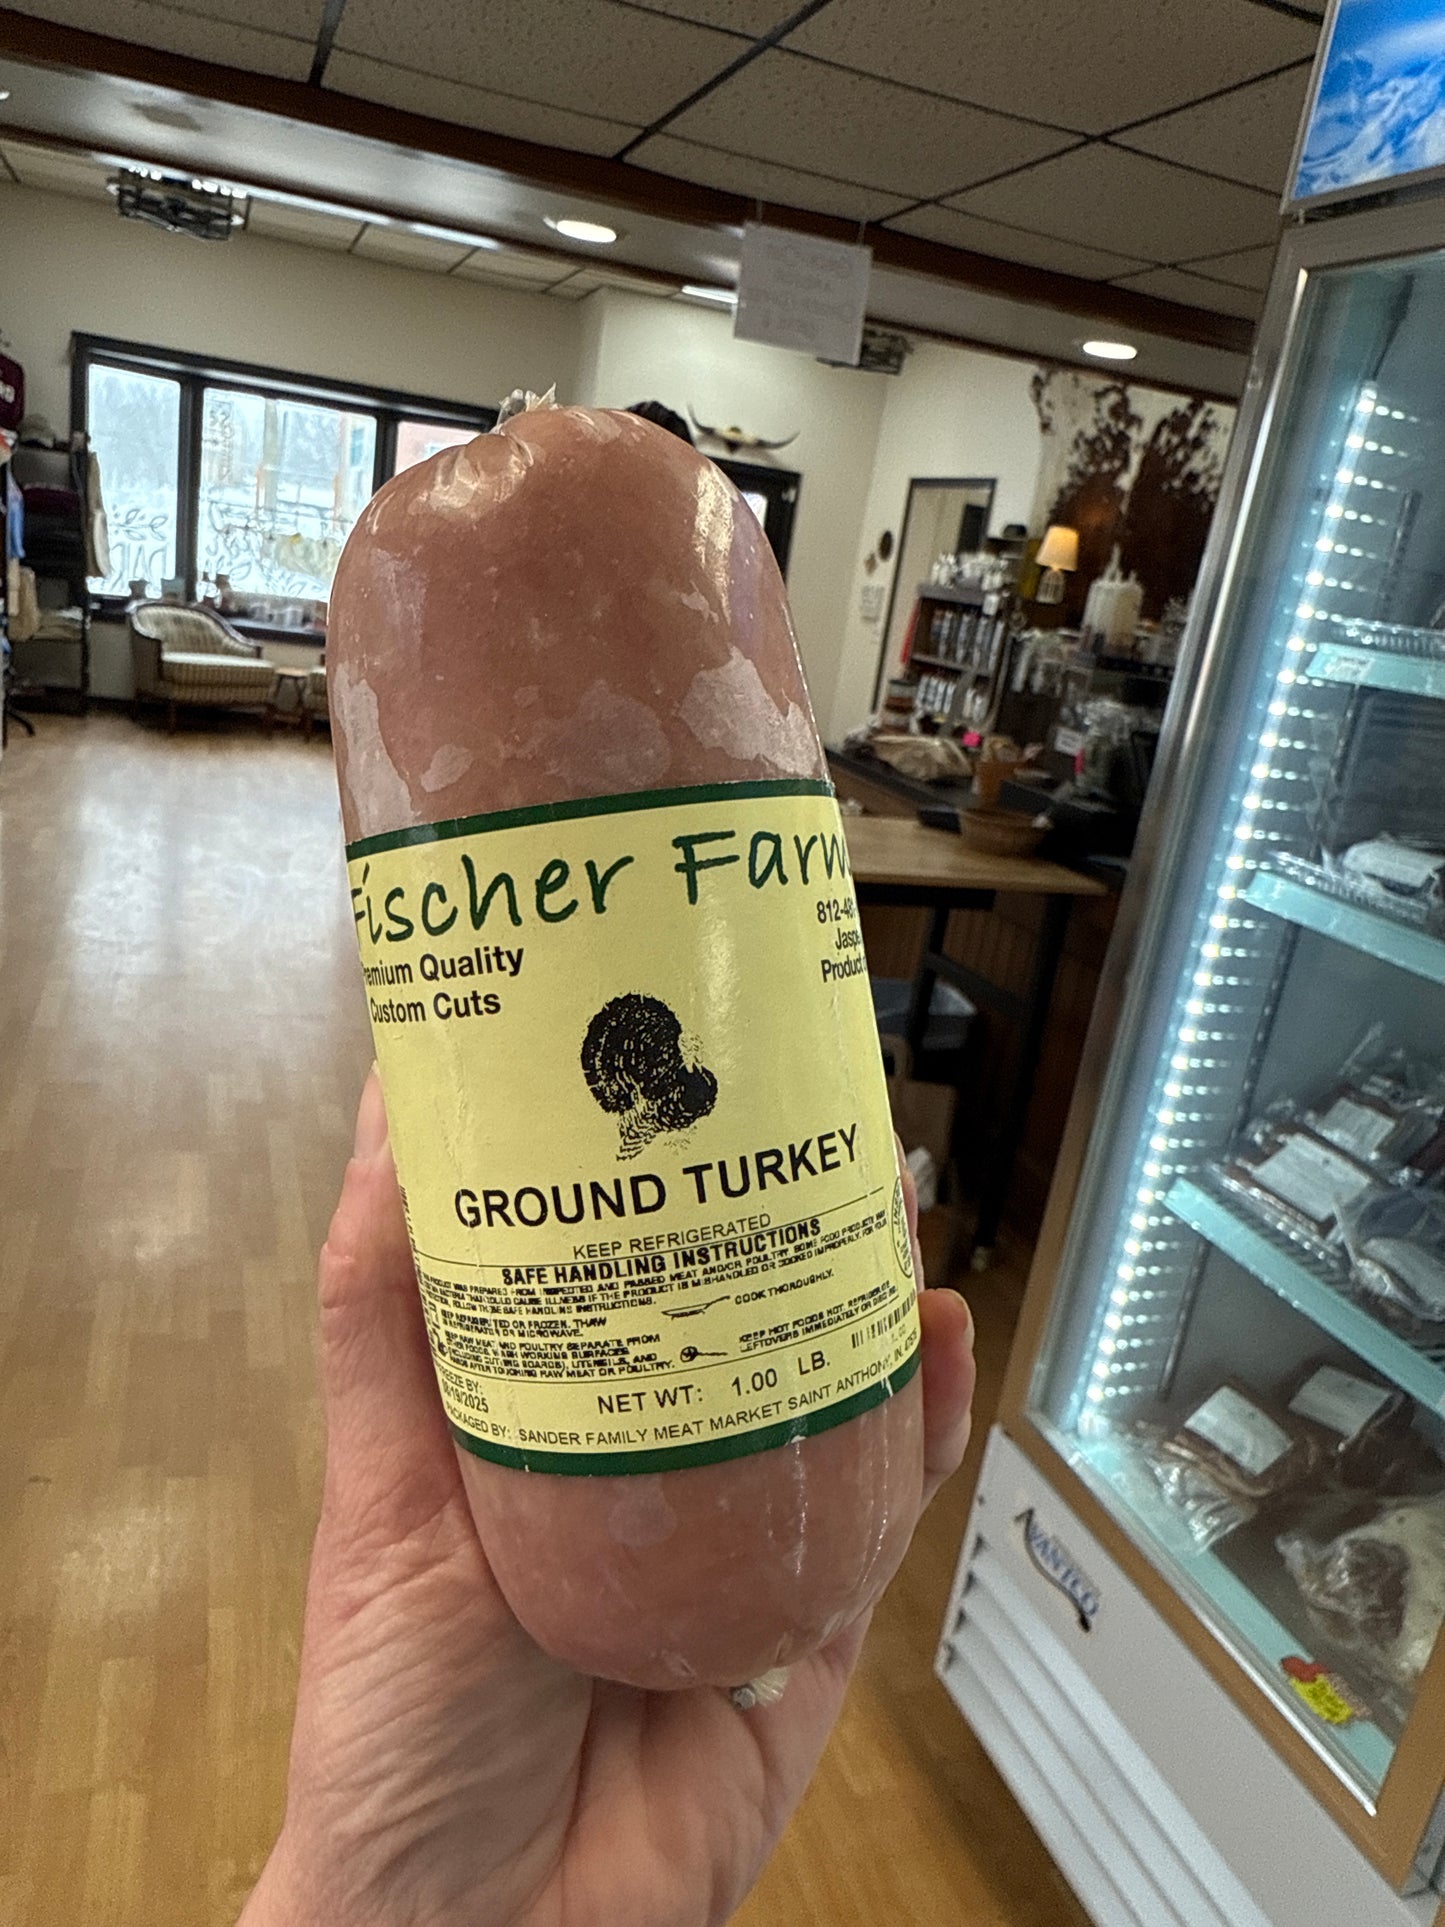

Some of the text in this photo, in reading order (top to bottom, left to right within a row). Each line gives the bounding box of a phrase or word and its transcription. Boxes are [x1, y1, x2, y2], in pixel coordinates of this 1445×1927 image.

[420, 946, 524, 981] Quality
[370, 990, 502, 1024] Custom Cuts
[454, 1123, 857, 1229] GROUND TURKEY
[573, 1212, 771, 1260] KEEP REFRIGERATED
[501, 1218, 821, 1286] SAFE HANDLING INSTRUCTIONS
[588, 1294, 599, 1303] IF
[600, 1291, 620, 1301] THE
[623, 1283, 674, 1298] PRODUCT
[761, 1261, 776, 1273] OR
[670, 1269, 698, 1282] MEAT
[735, 1288, 767, 1305] COOK
[512, 1320, 527, 1329] OR
[768, 1324, 790, 1336] HOT
[519, 1342, 563, 1352] POULTRY
[627, 1333, 661, 1347] FROM
[567, 1368, 595, 1378] MEAT
[599, 1368, 616, 1376] OR
[619, 1360, 675, 1375] POULTRY.
[634, 1353, 657, 1363] AND
[466, 1378, 484, 1396] BY:
[598, 1350, 830, 1415] NET WT: 1.00 LB.
[491, 1423, 512, 1440] BY:
[519, 1428, 582, 1446] SANDER
[585, 1429, 648, 1446] FAMILY
[654, 1420, 704, 1441] MEAT
[710, 1401, 782, 1431] MARKET
[788, 1384, 831, 1411] SAINT
